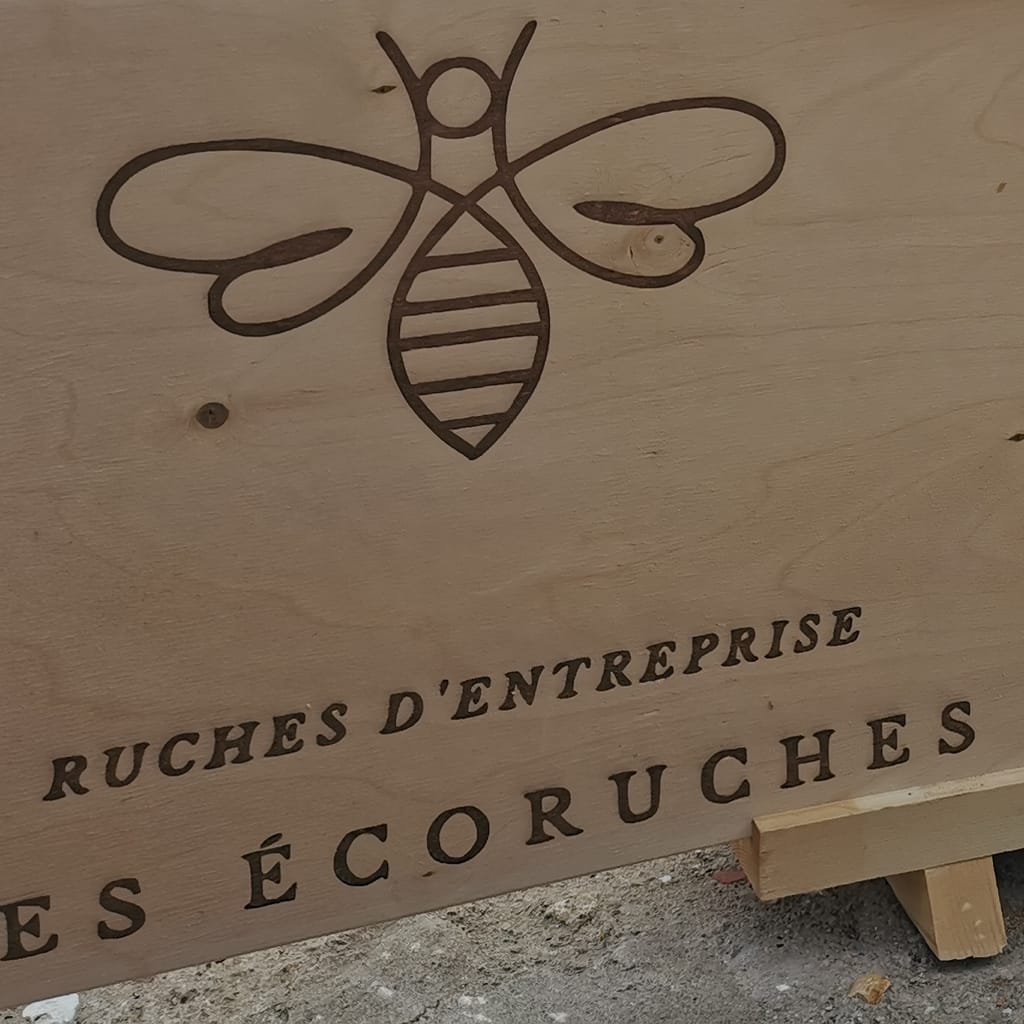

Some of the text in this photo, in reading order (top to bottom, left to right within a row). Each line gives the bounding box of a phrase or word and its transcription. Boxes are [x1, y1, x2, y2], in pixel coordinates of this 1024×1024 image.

[41, 606, 862, 802] RUCHES D'ENTREPRISE
[240, 700, 976, 911] ÉCORUCHES
